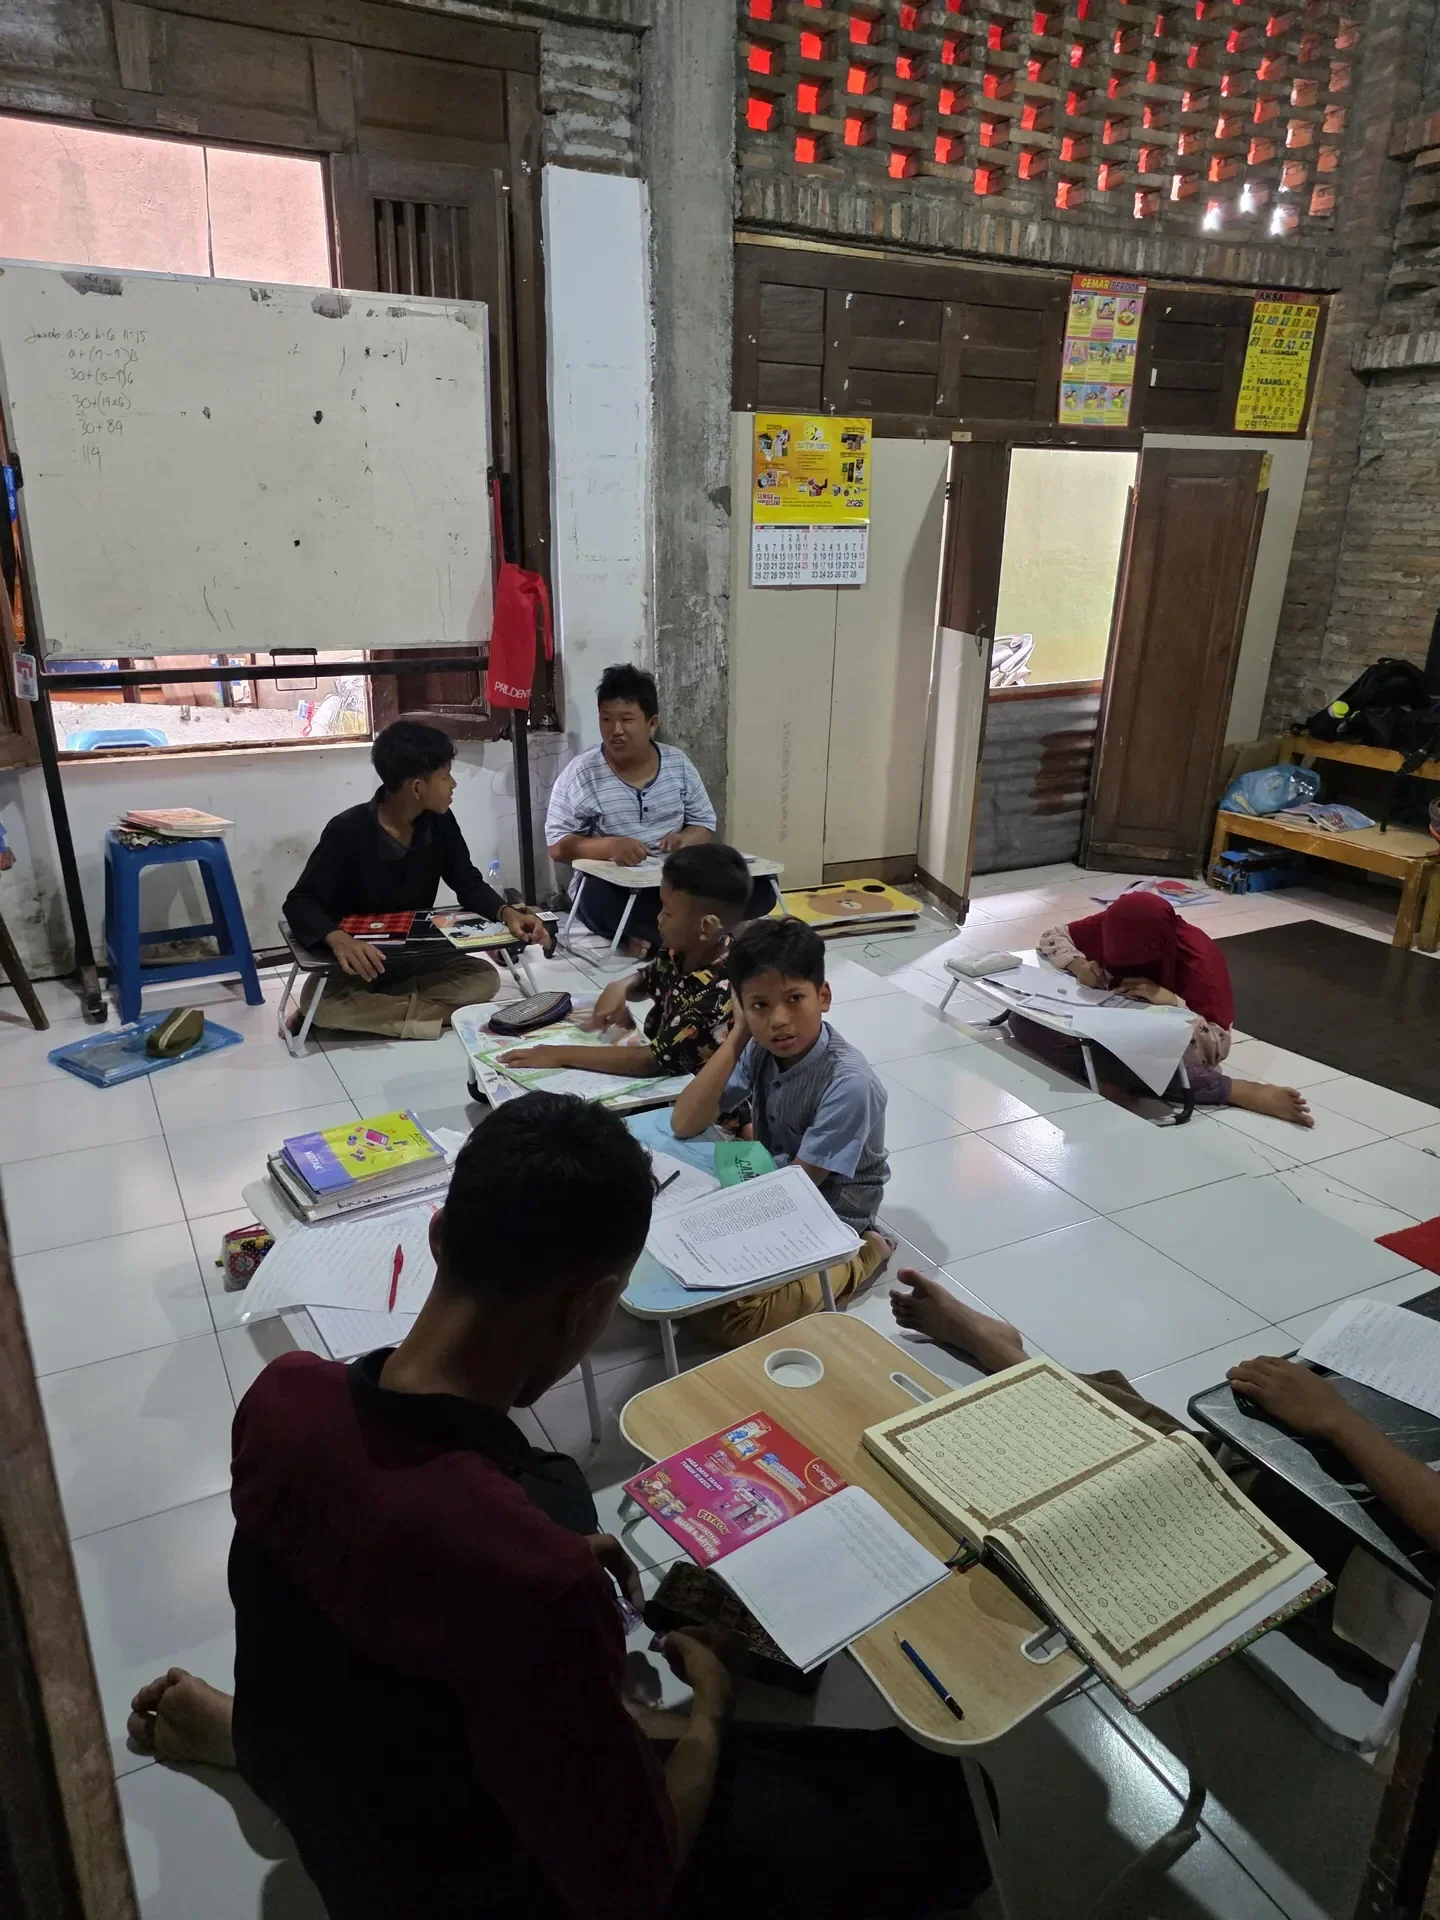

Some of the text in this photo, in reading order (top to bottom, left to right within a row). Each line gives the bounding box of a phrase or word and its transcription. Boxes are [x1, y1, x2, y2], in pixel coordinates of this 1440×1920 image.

[1080, 278, 1109, 290] GEMAR
[811, 1464, 837, 1488] Curcuma
[820, 1478, 833, 1491] Plus
